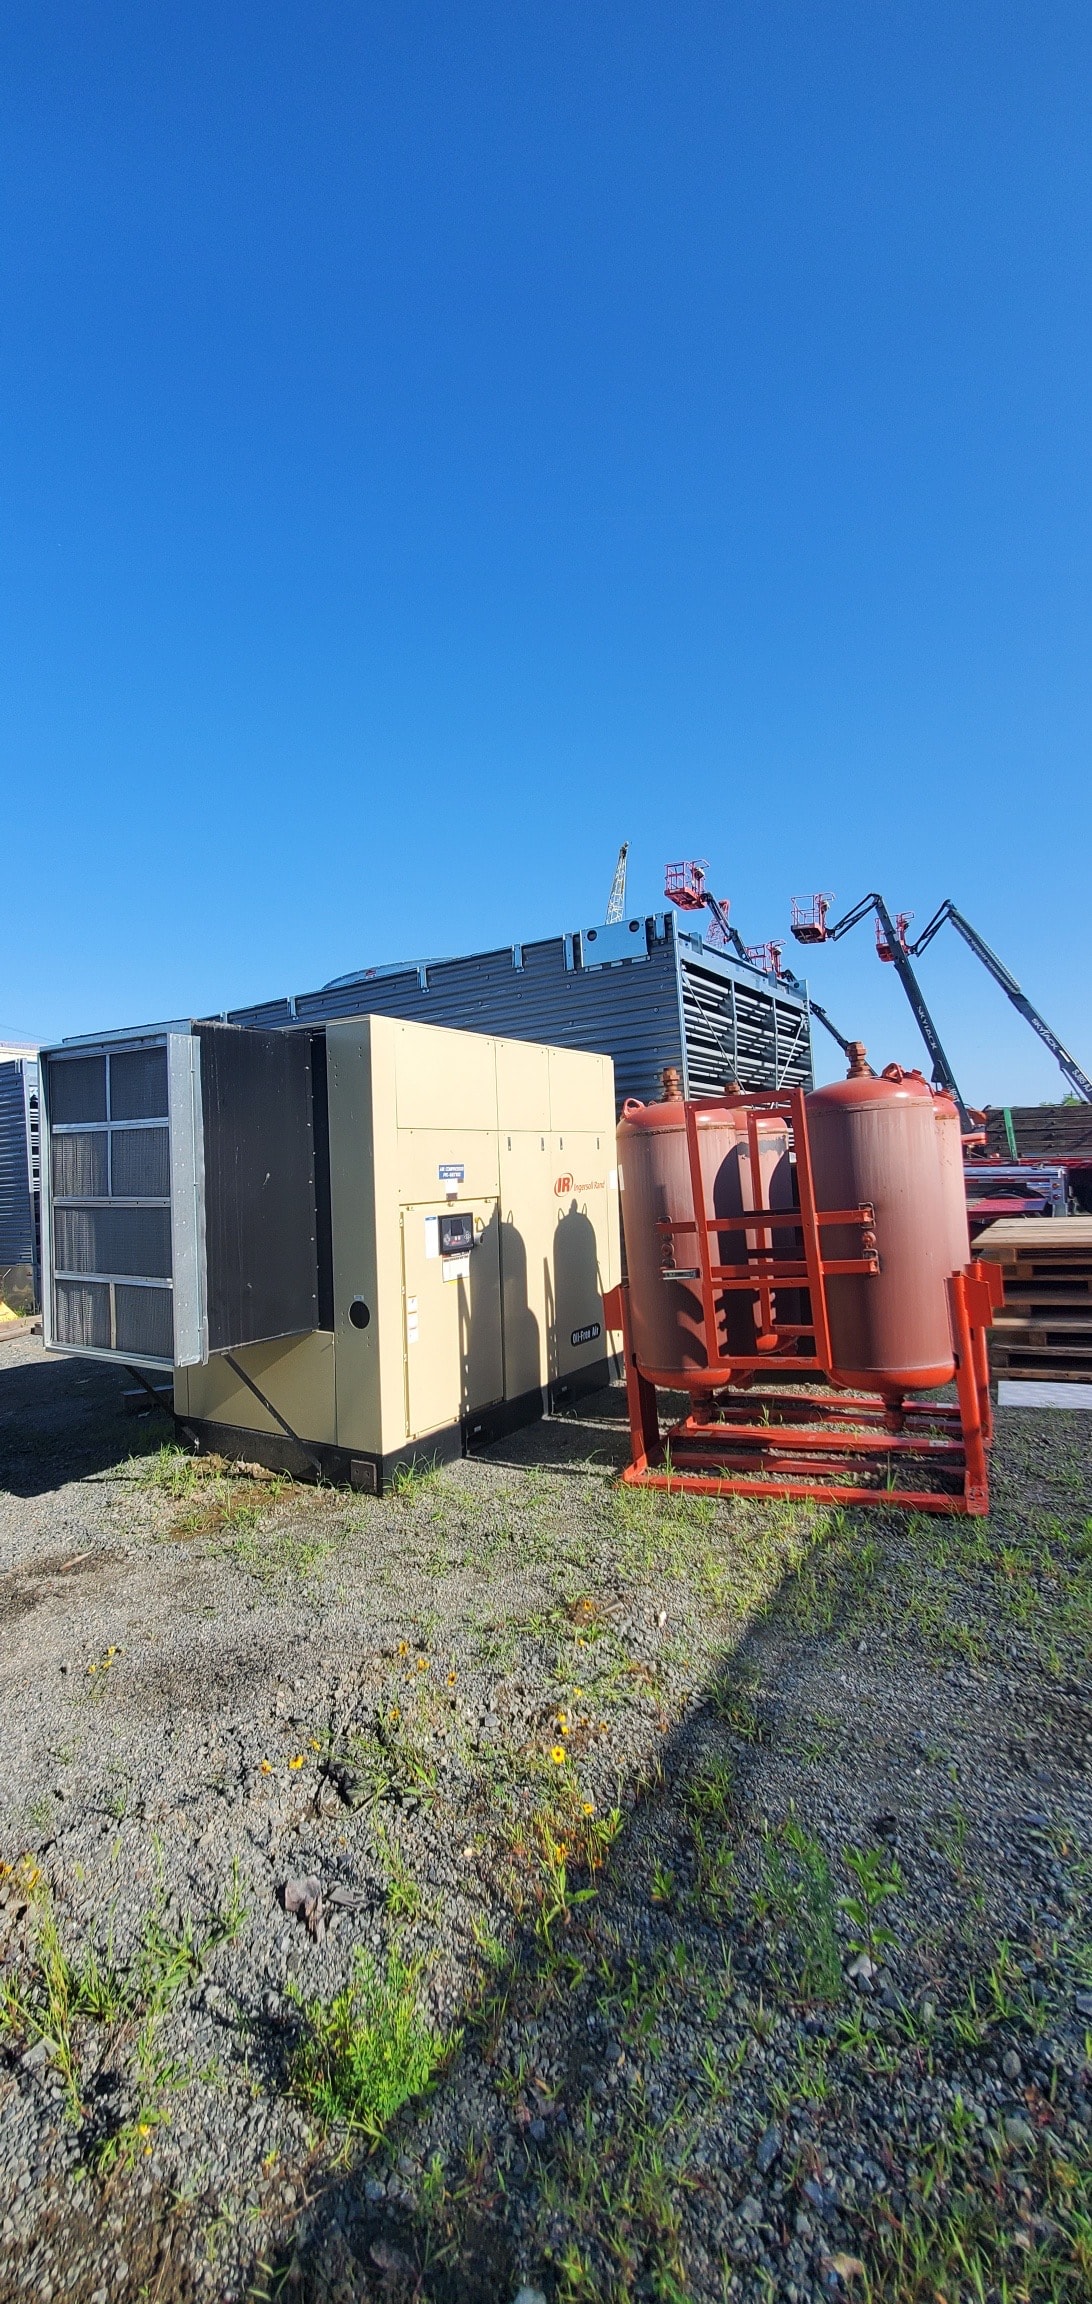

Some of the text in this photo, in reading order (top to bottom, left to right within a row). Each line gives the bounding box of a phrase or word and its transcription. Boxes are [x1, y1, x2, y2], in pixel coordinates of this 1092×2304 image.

[917, 1005, 938, 1050] SKYJACK
[1031, 1018, 1060, 1050] SKYJACK
[557, 1177, 605, 1193] IR Ingersoll Rand
